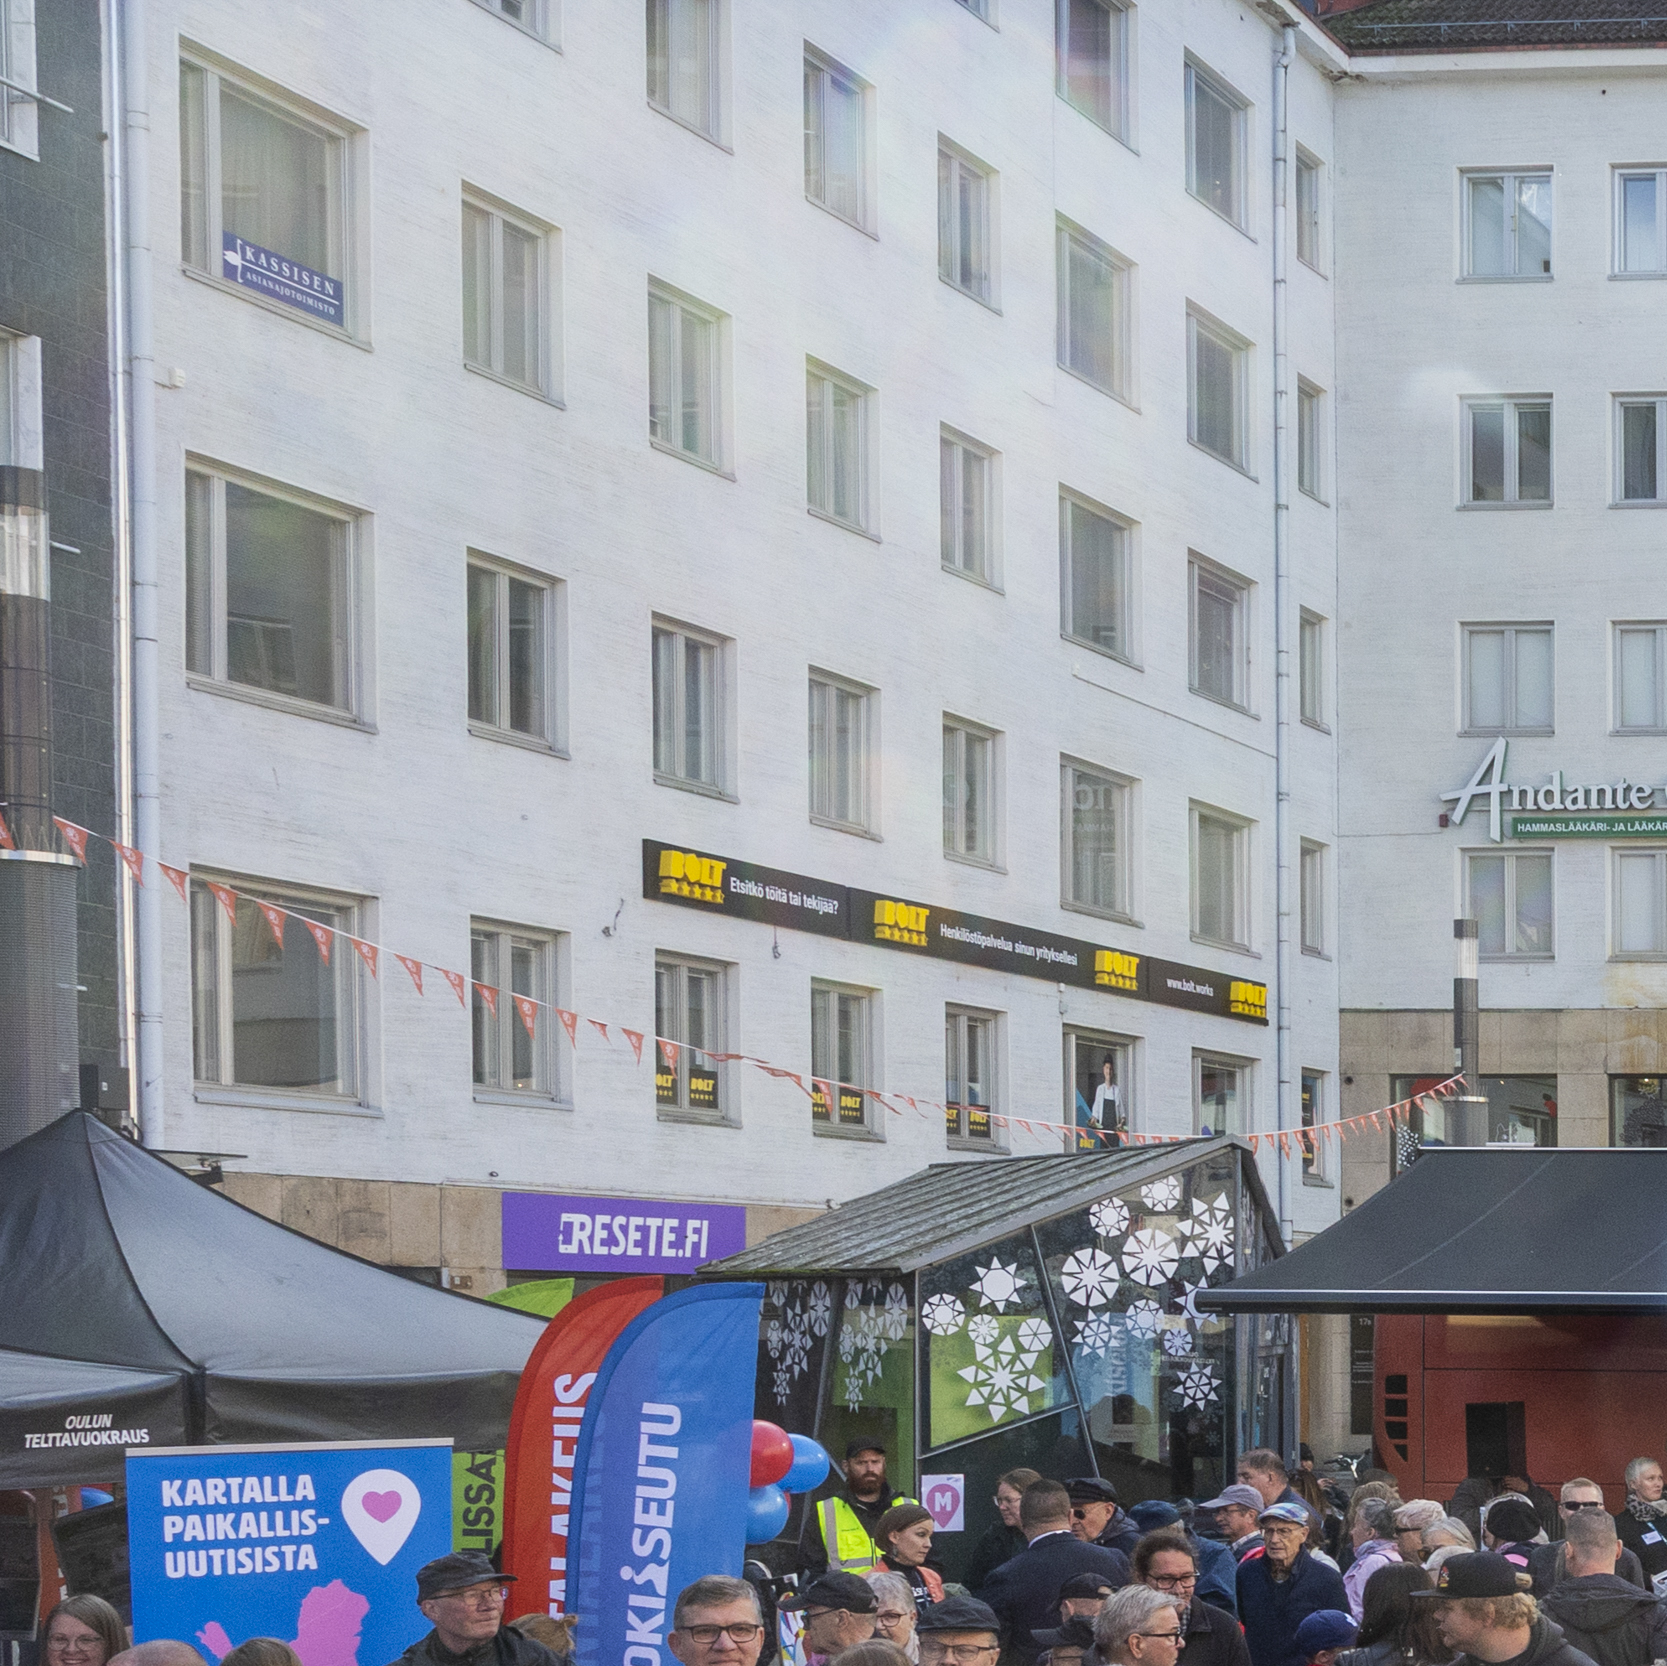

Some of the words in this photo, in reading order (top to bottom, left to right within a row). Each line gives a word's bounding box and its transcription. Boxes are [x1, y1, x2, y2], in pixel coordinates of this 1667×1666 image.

[245, 246, 334, 296] KASSISEN
[246, 272, 335, 315] ASIANAJOTOIMISTO
[1440, 736, 1654, 843] Andante
[1517, 821, 1611, 832] HAMMASLÄÄKÄRI-
[1612, 821, 1626, 832] JA
[659, 849, 727, 888] BOLT
[730, 877, 764, 898] Etsitkö
[766, 886, 787, 903] töitä
[789, 892, 801, 906] tai
[803, 894, 839, 915] tekijää?
[873, 899, 930, 932] BOLT
[940, 924, 1013, 952] Henkilöstöpalvelua
[1014, 941, 1035, 957] sinun
[1036, 945, 1078, 966] yrityksellesi
[1095, 950, 1140, 978] BOLT
[1166, 978, 1214, 997] www.bolt.works
[1230, 981, 1268, 1007] BOLT
[690, 1077, 715, 1092] BOLT
[840, 1095, 861, 1109] BOLT
[559, 1213, 709, 1258] RESETE.FI
[65, 1414, 113, 1429] OULUN
[25, 1429, 150, 1449] TELTTAVUOKRAUS
[162, 1474, 316, 1507] KARTALLA
[934, 1492, 952, 1512] M
[163, 1509, 330, 1543] PAIKALLIS-
[164, 1545, 319, 1579] UUTISISTA
